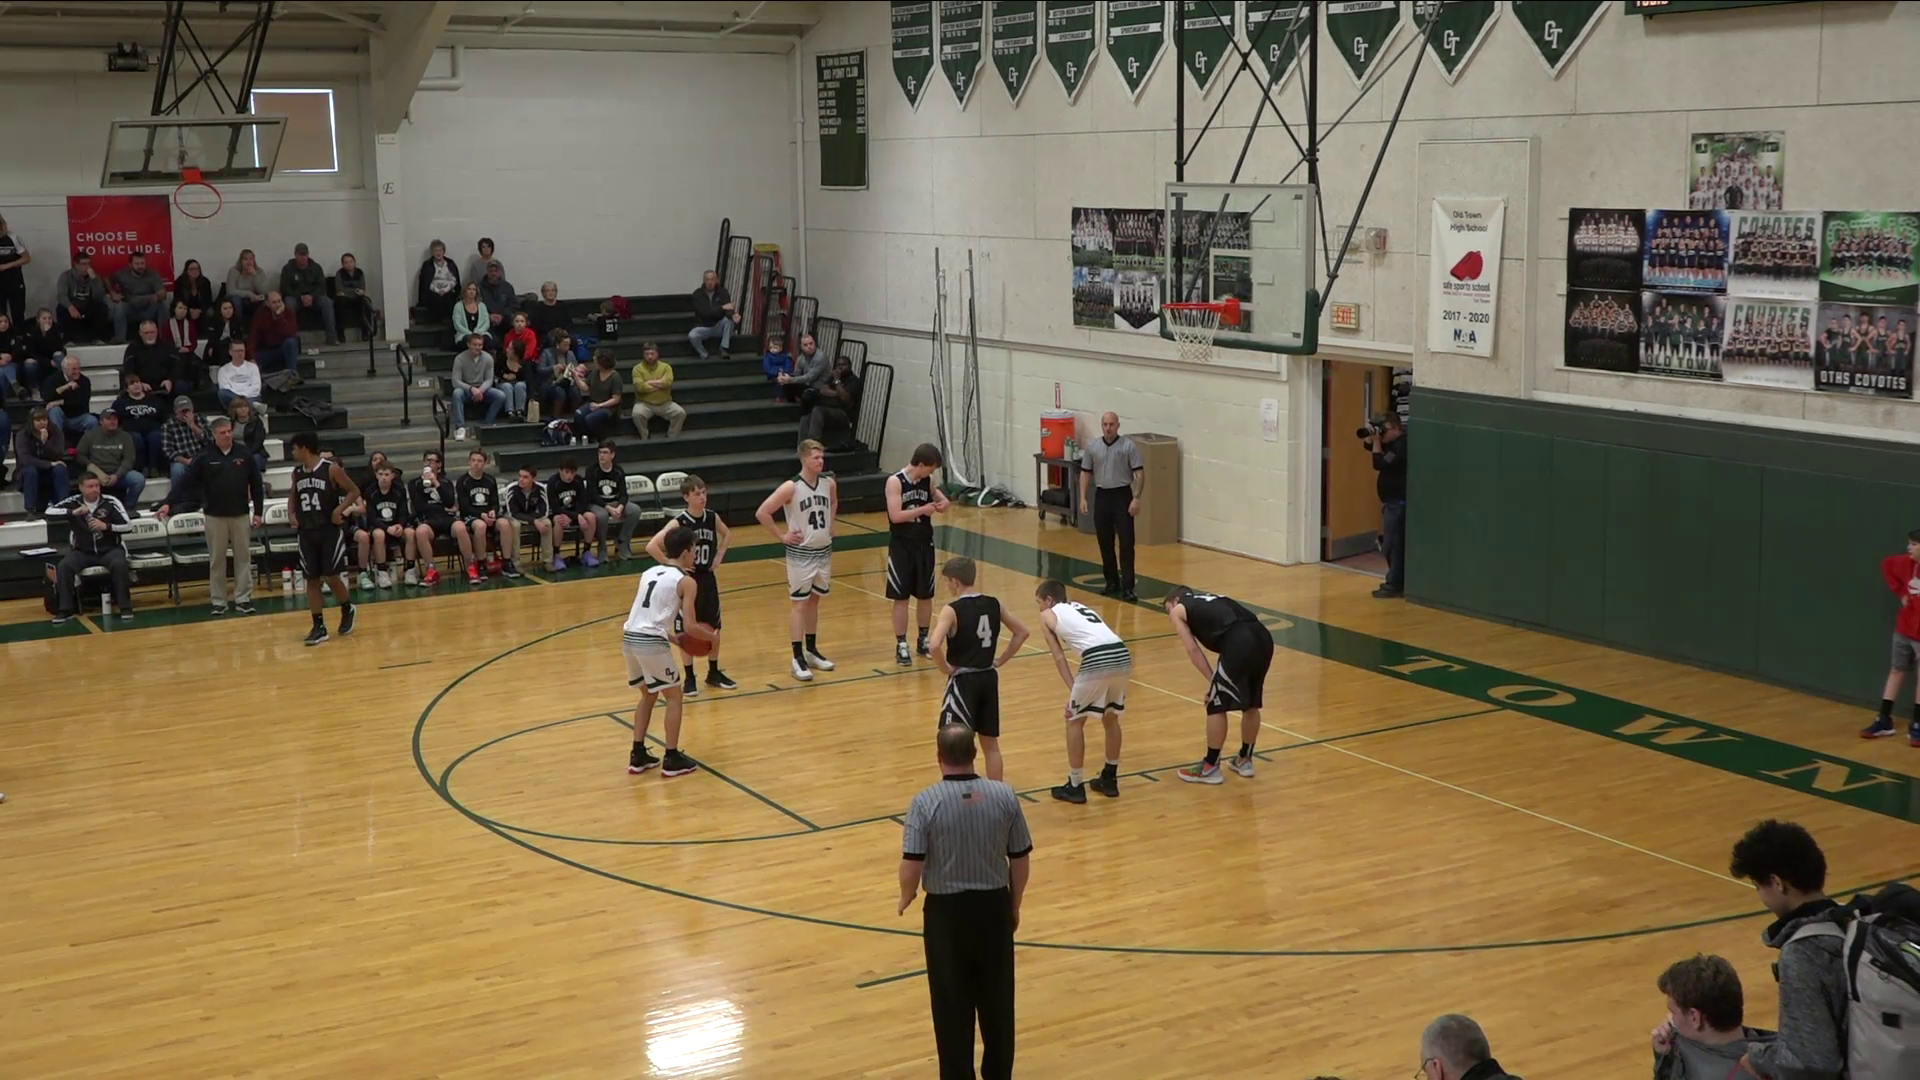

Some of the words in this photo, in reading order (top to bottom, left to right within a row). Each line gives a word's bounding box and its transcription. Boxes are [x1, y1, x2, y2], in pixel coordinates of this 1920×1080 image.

[1452, 211, 1463, 219] Old
[1464, 211, 1482, 219] Town
[76, 231, 137, 242] CHOOSE
[1449, 224, 1465, 234] High
[1466, 224, 1488, 232] School
[77, 246, 96, 256] TO
[102, 243, 165, 255] INCLUDE.
[1336, 306, 1352, 324] EXIT
[1443, 310, 1461, 321] 2017
[1469, 312, 1490, 323] 2020
[1820, 370, 1850, 385] OTHS
[1854, 373, 1906, 390] COYOTES
[301, 492, 321, 512] 24
[800, 501, 812, 513] OLD
[808, 510, 826, 530] 43
[641, 580, 658, 609] 1
[1074, 606, 1103, 624] 5
[976, 614, 993, 648] 4
[1380, 655, 1906, 794] TOWN
